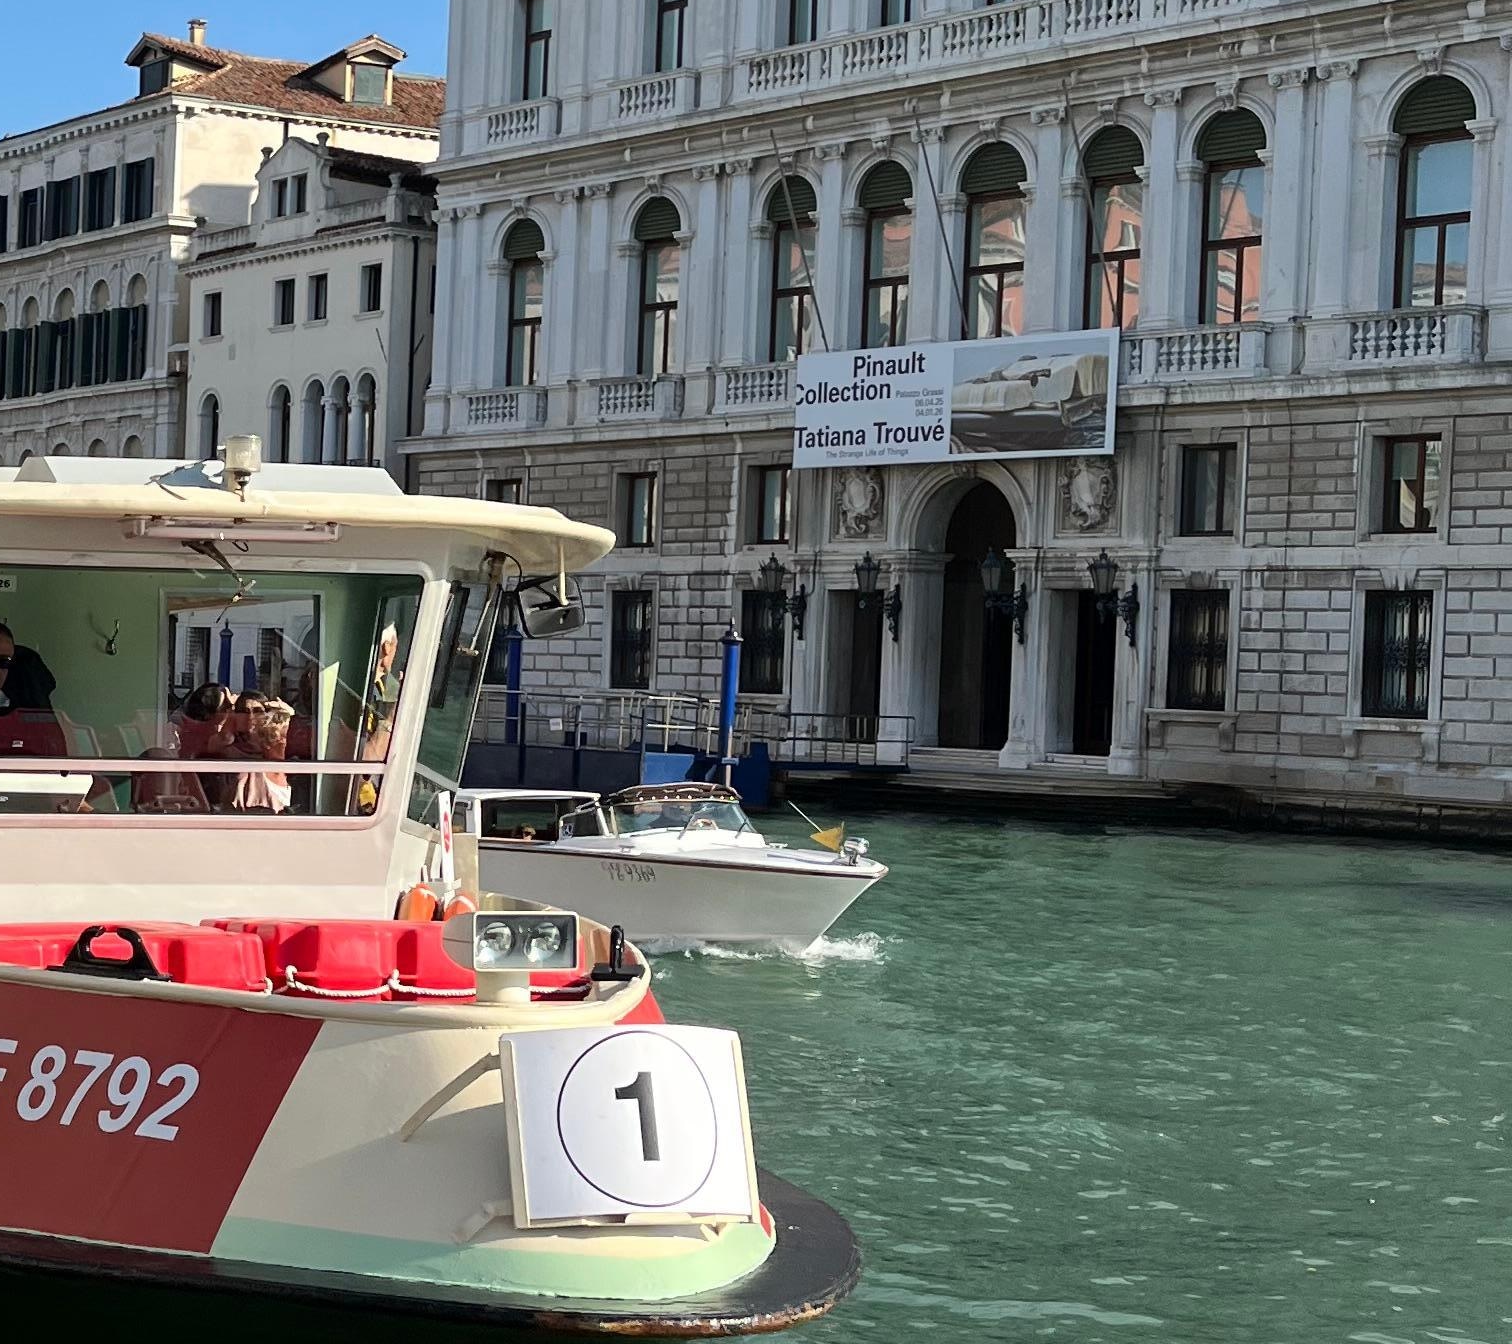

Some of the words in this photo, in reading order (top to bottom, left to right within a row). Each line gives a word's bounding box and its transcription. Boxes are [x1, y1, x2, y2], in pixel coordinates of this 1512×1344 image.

[853, 351, 926, 378] Pinault
[796, 379, 891, 406] Collection
[794, 425, 866, 449] Tatiana
[873, 418, 945, 444] Trouvé
[826, 450, 838, 459] The
[838, 449, 863, 459] Strange
[865, 448, 877, 457] Life
[887, 447, 909, 457] Things
[16, 1044, 200, 1142] 8792
[614, 1071, 661, 1162] 1
